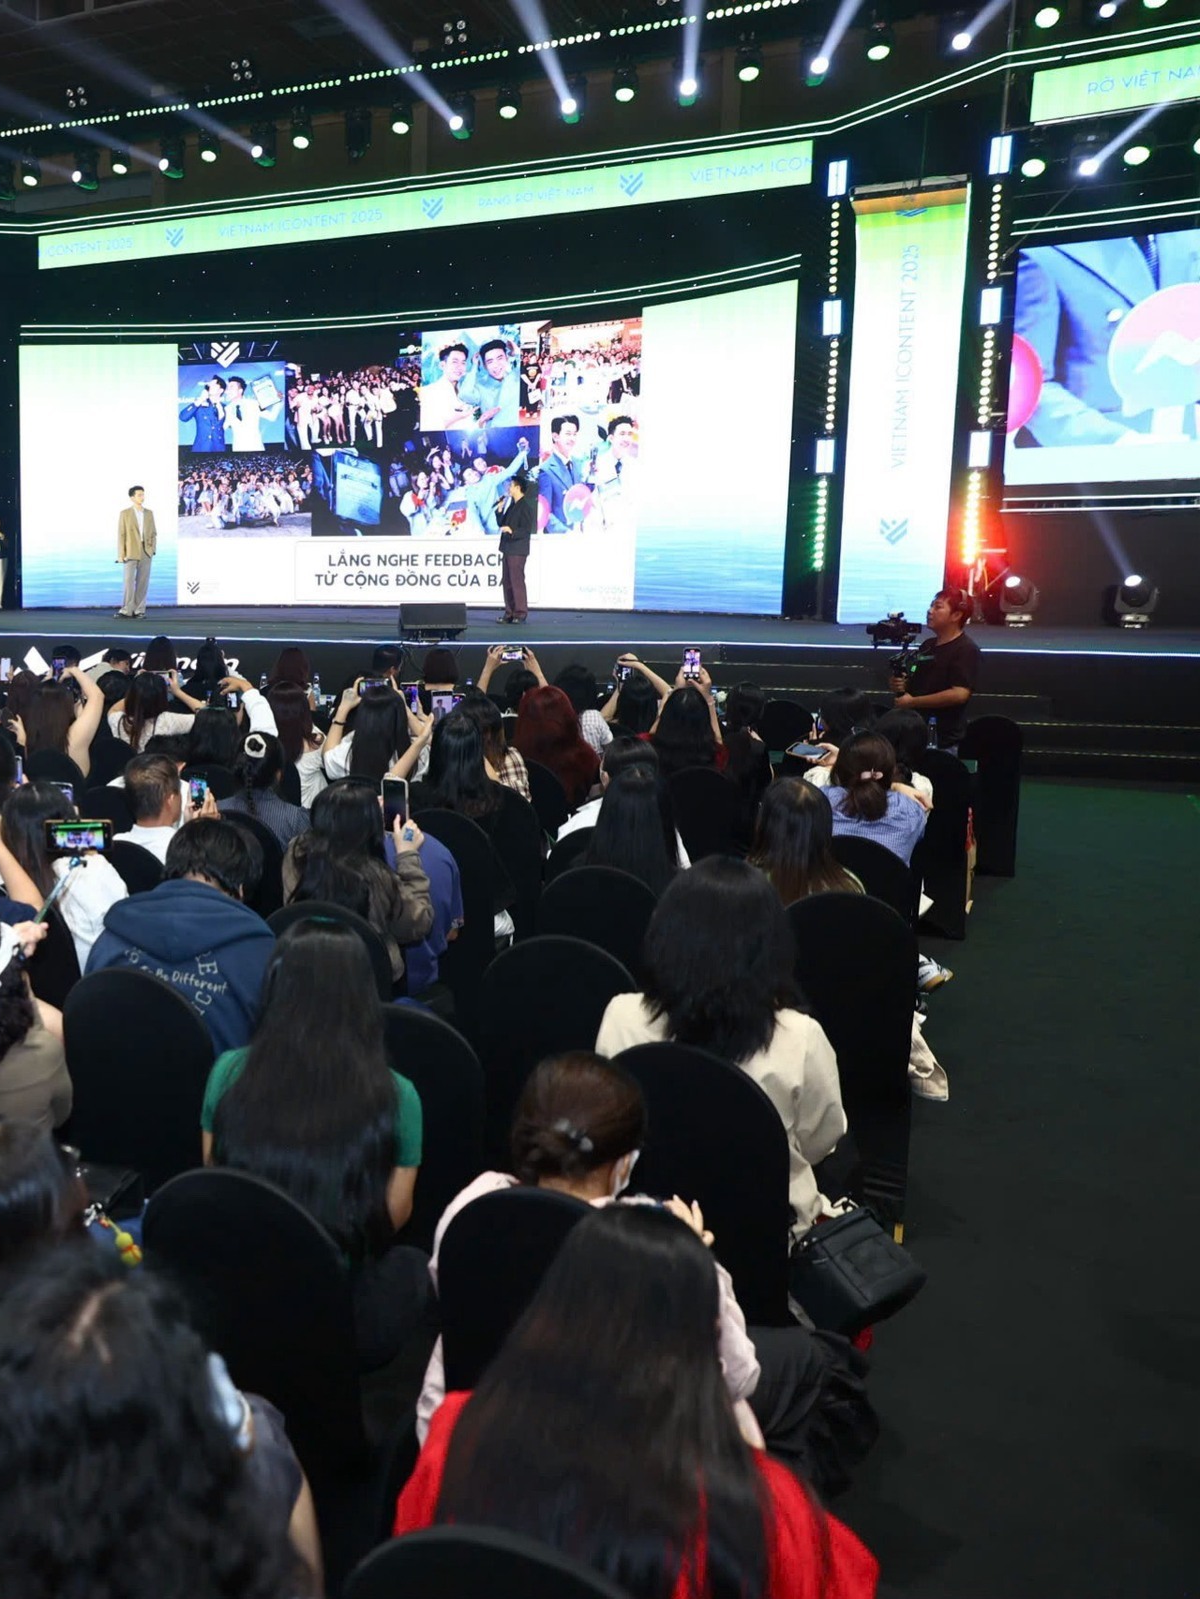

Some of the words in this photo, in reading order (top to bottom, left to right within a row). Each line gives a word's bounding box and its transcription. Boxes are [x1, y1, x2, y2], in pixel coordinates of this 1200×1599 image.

[690, 162, 764, 182] VIETNAM
[218, 222, 273, 239] VIETNAM
[350, 207, 383, 224] 2025
[900, 244, 920, 282] 2025
[894, 289, 918, 383] ICONTENT
[890, 389, 912, 469] VIETNAM
[377, 553, 419, 567] NGHE
[315, 571, 337, 586] TỪ
[343, 570, 389, 589] CỘNG
[395, 569, 441, 587] ĐỒNG
[447, 569, 481, 587] CỦA
[171, 969, 228, 997] Different
